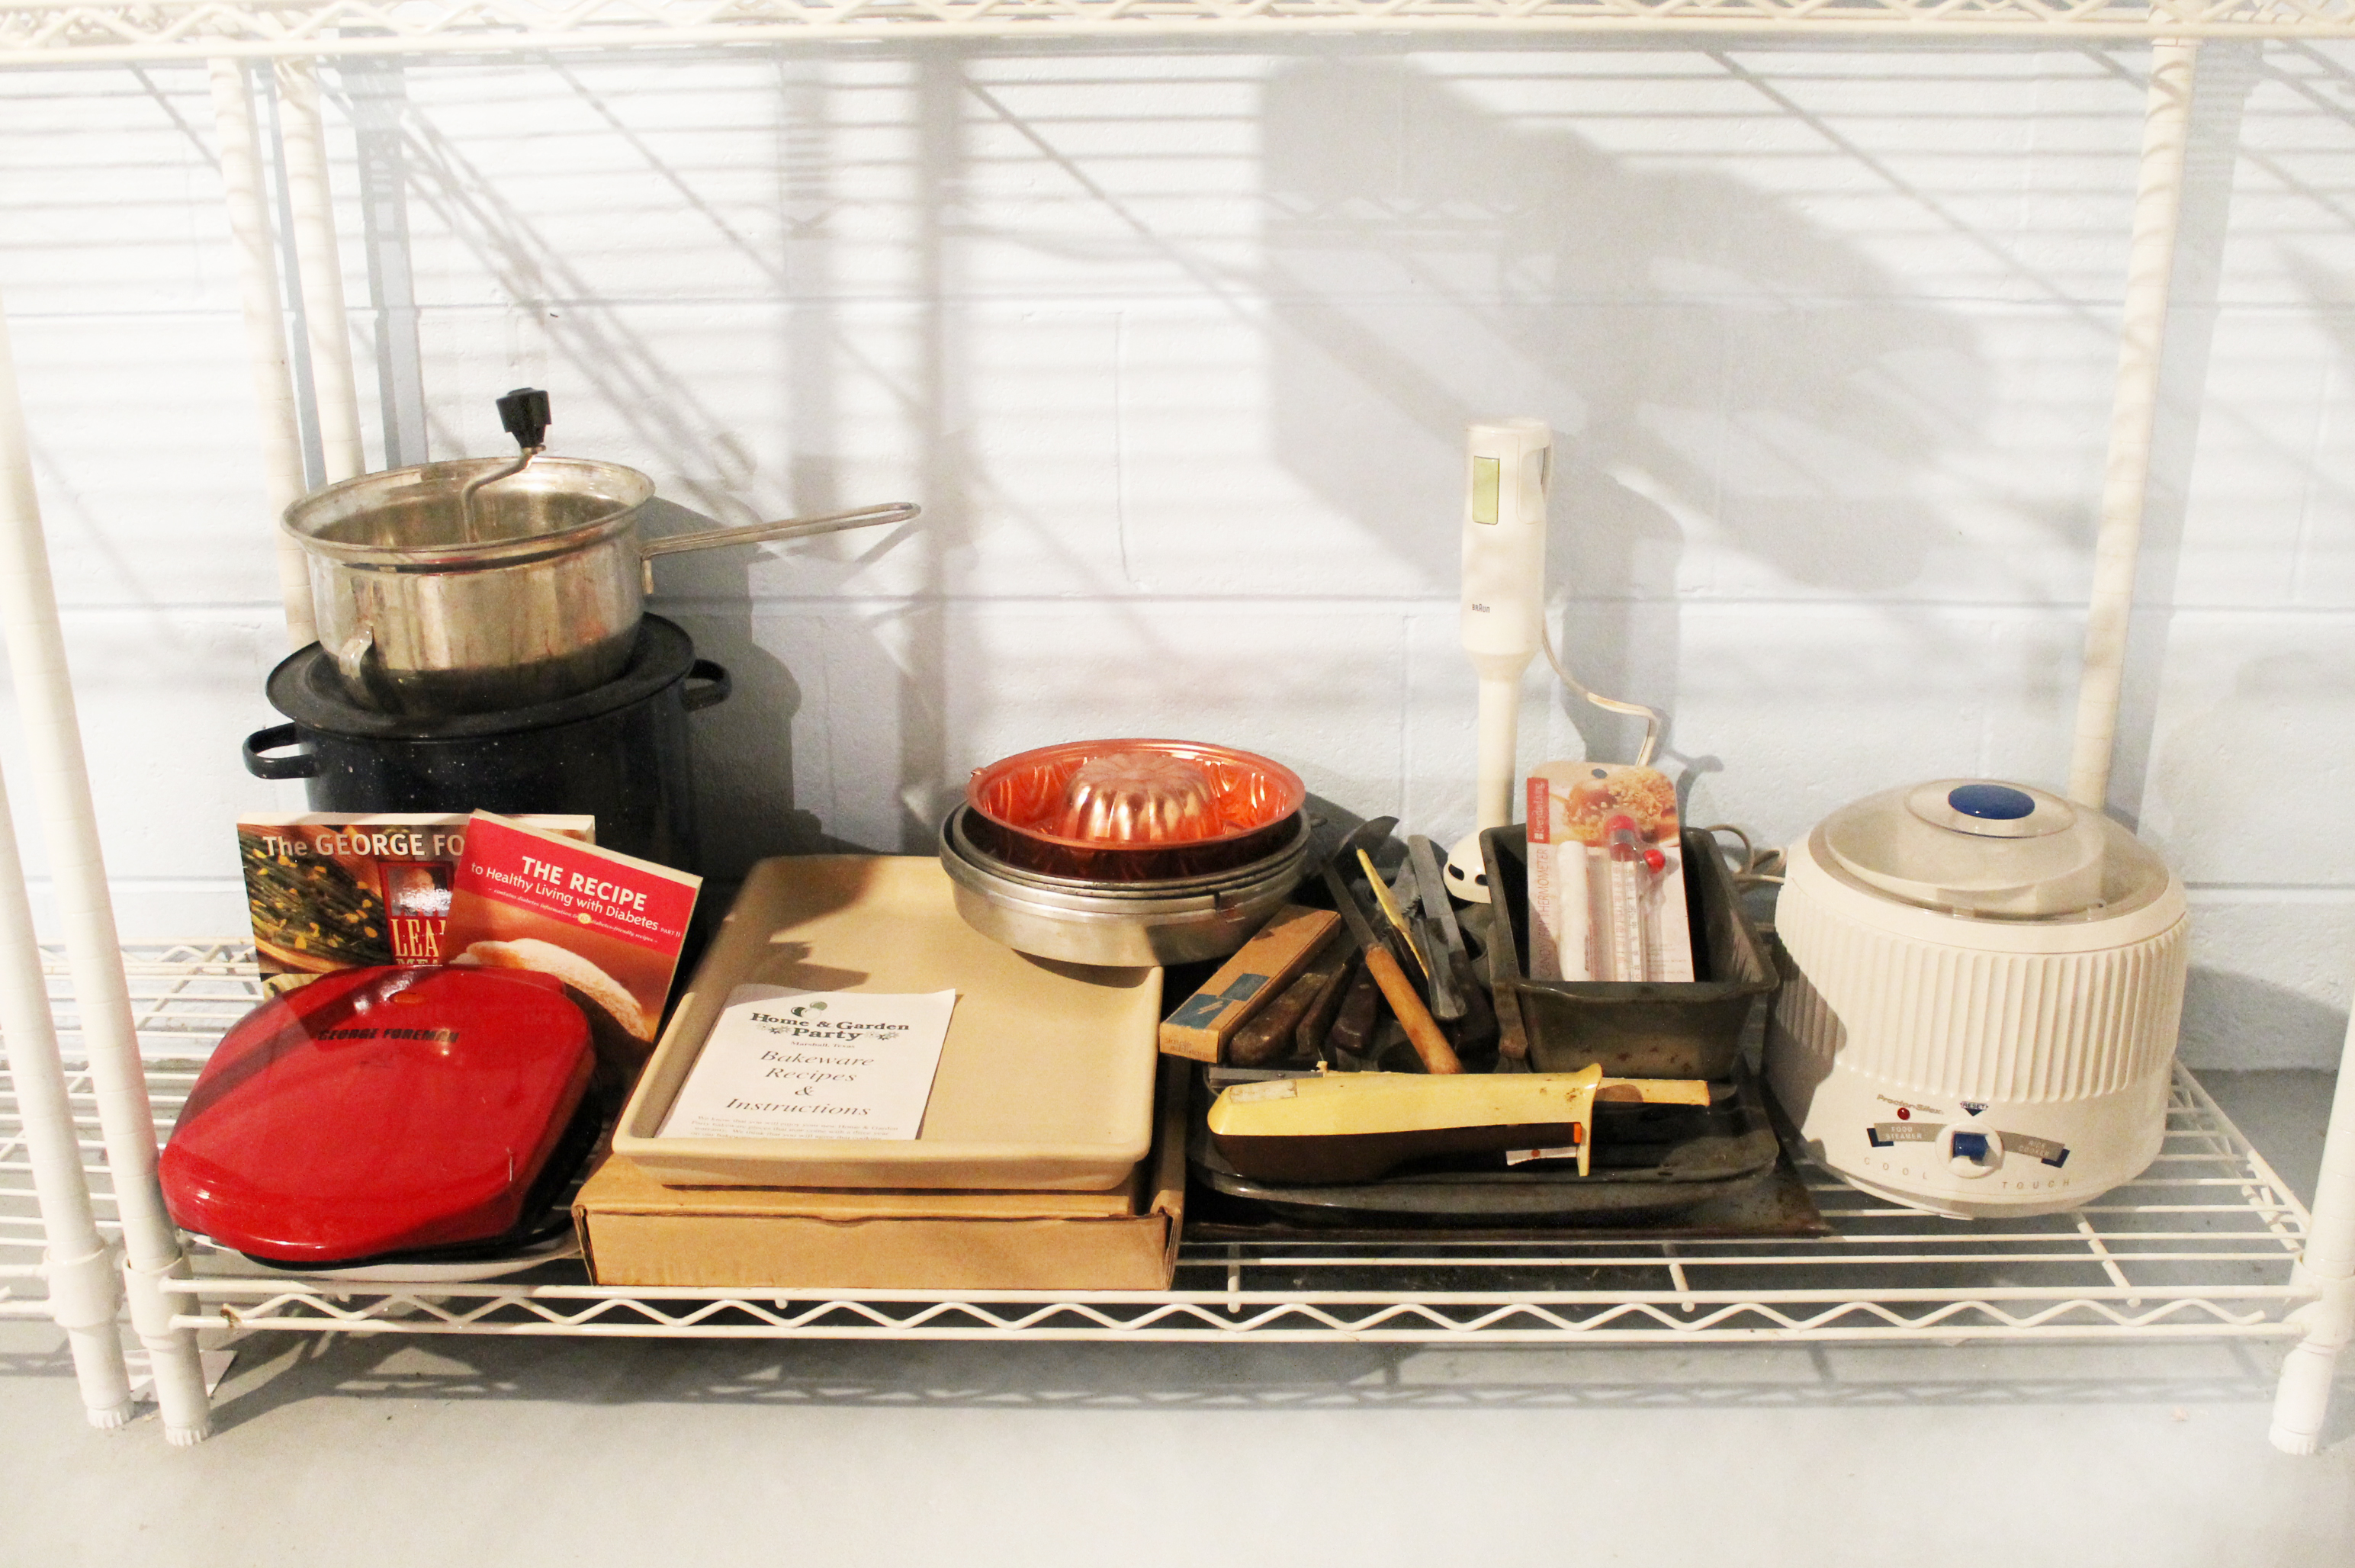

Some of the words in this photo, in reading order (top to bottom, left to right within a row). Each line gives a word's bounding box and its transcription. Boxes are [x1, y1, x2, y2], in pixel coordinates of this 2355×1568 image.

[1472, 603, 1490, 613] BRAUN
[263, 836, 307, 856] The
[315, 834, 426, 856] GEORGE
[522, 856, 564, 885] THE
[570, 872, 647, 911] RECIPE
[1537, 849, 1550, 917] THERMOMETER
[471, 862, 484, 876] to
[486, 867, 534, 894] Healthy
[535, 884, 574, 907] Living
[577, 897, 604, 914] with
[606, 905, 659, 931] Diabetes
[517, 895, 540, 907] diabetes
[390, 918, 446, 957] LEA
[660, 927, 675, 937] PART
[750, 1013, 810, 1027] Home
[837, 1021, 910, 1030] Garden
[318, 1029, 379, 1040] GEORGE
[383, 1029, 459, 1043] FOREMAN
[792, 1027, 863, 1042] Party
[760, 1050, 875, 1066] Bakeware
[765, 1068, 857, 1083] Recipes
[795, 1085, 814, 1097] &
[725, 1098, 871, 1117] Instructions
